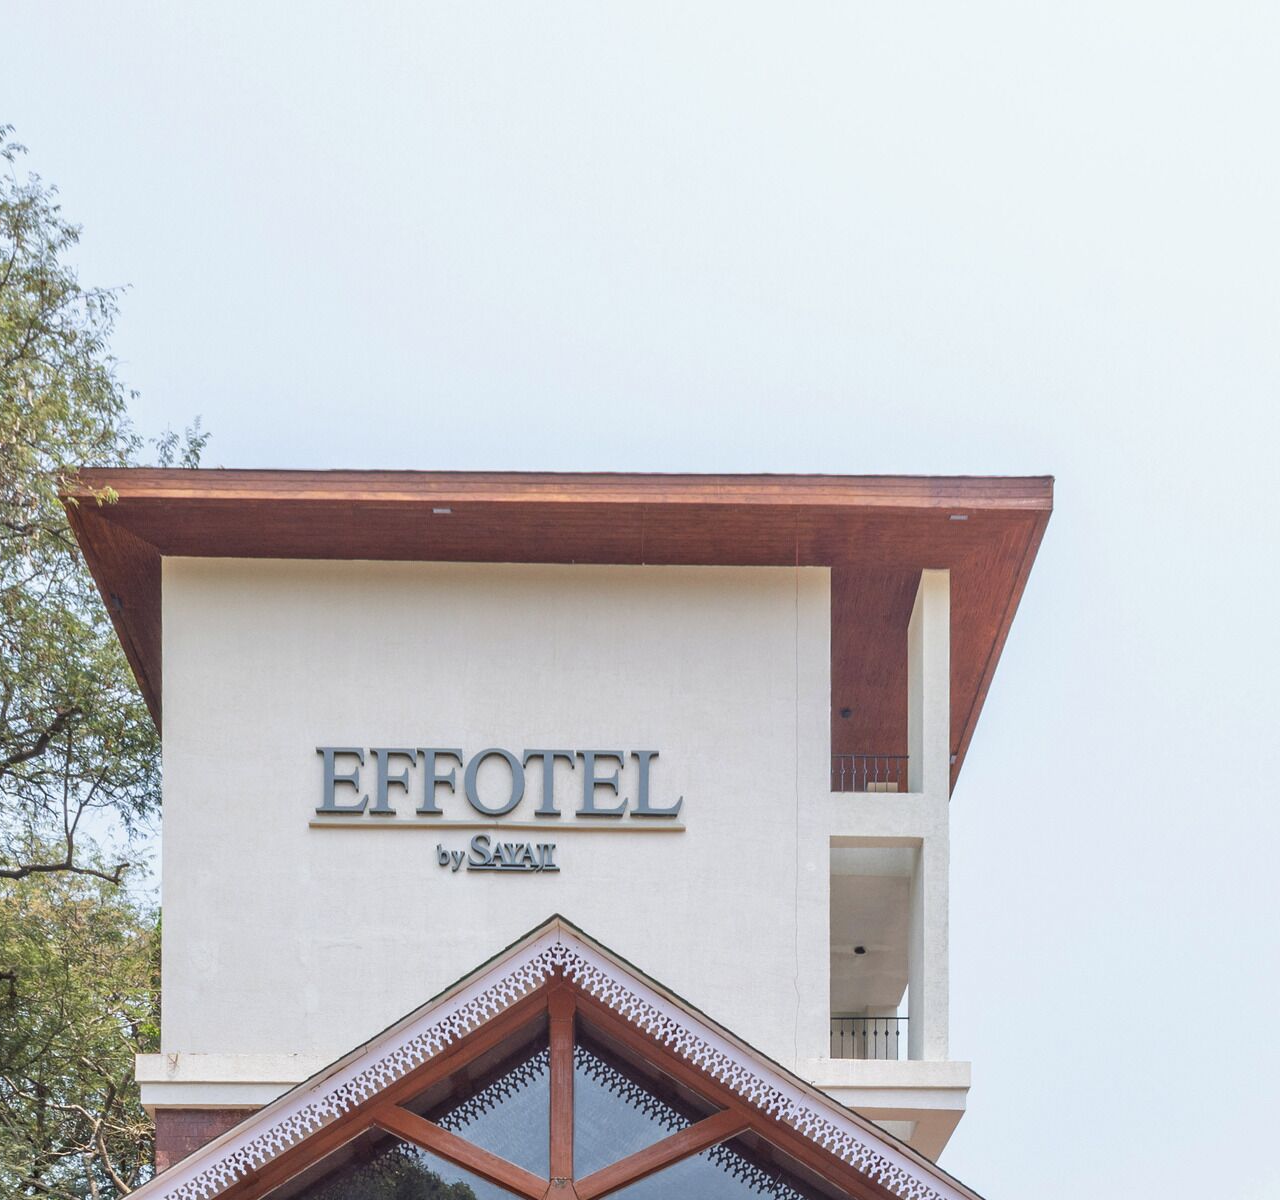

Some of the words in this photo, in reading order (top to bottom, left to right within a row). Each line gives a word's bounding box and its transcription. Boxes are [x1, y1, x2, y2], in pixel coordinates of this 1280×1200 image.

[315, 746, 684, 817] EFFOTEL
[436, 843, 466, 872] by
[467, 834, 559, 872] SAYAJI
